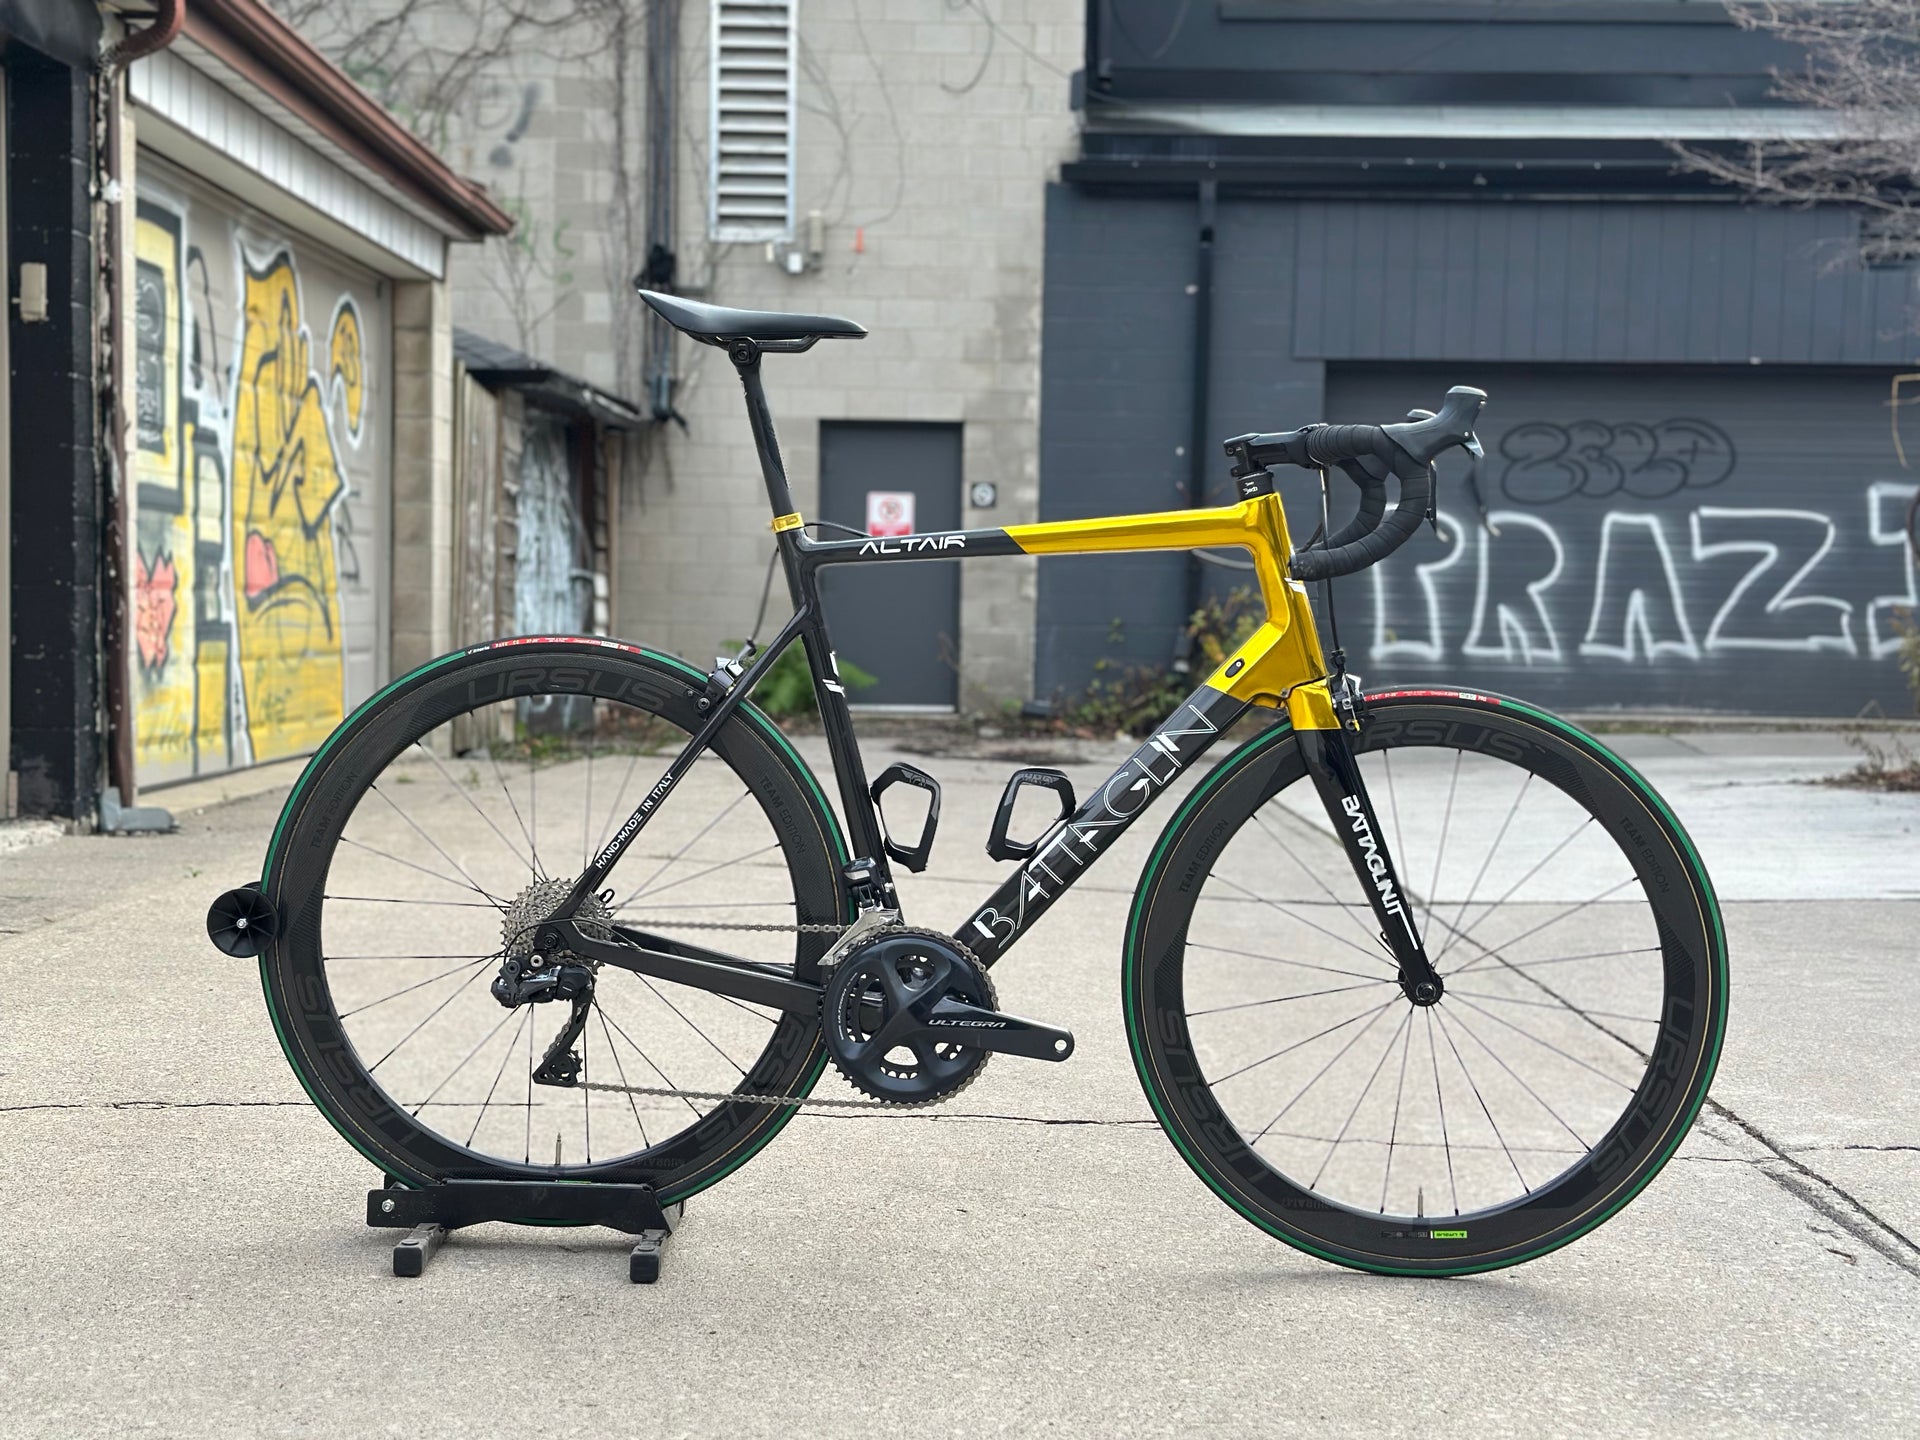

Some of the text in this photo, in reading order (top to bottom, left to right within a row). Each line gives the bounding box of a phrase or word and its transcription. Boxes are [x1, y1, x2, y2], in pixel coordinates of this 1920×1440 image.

[859, 535, 966, 555] ALTAIR
[468, 667, 672, 711] URSUS
[1352, 719, 1530, 760] RSUS
[310, 772, 359, 848] TEAM EDITION
[595, 772, 673, 869] HAND-MADE IN ITALY
[759, 776, 807, 854] TEAM EDITION
[972, 704, 1219, 948] BATTAGLIN
[1179, 819, 1229, 892] TEAM EDITION
[1620, 816, 1670, 893] TEAM EDITION
[295, 973, 423, 1146] URSUS
[928, 1018, 1007, 1028] ULTEGRA
[1157, 1007, 1272, 1184] URSUS
[1591, 996, 1693, 1182] URSUS
